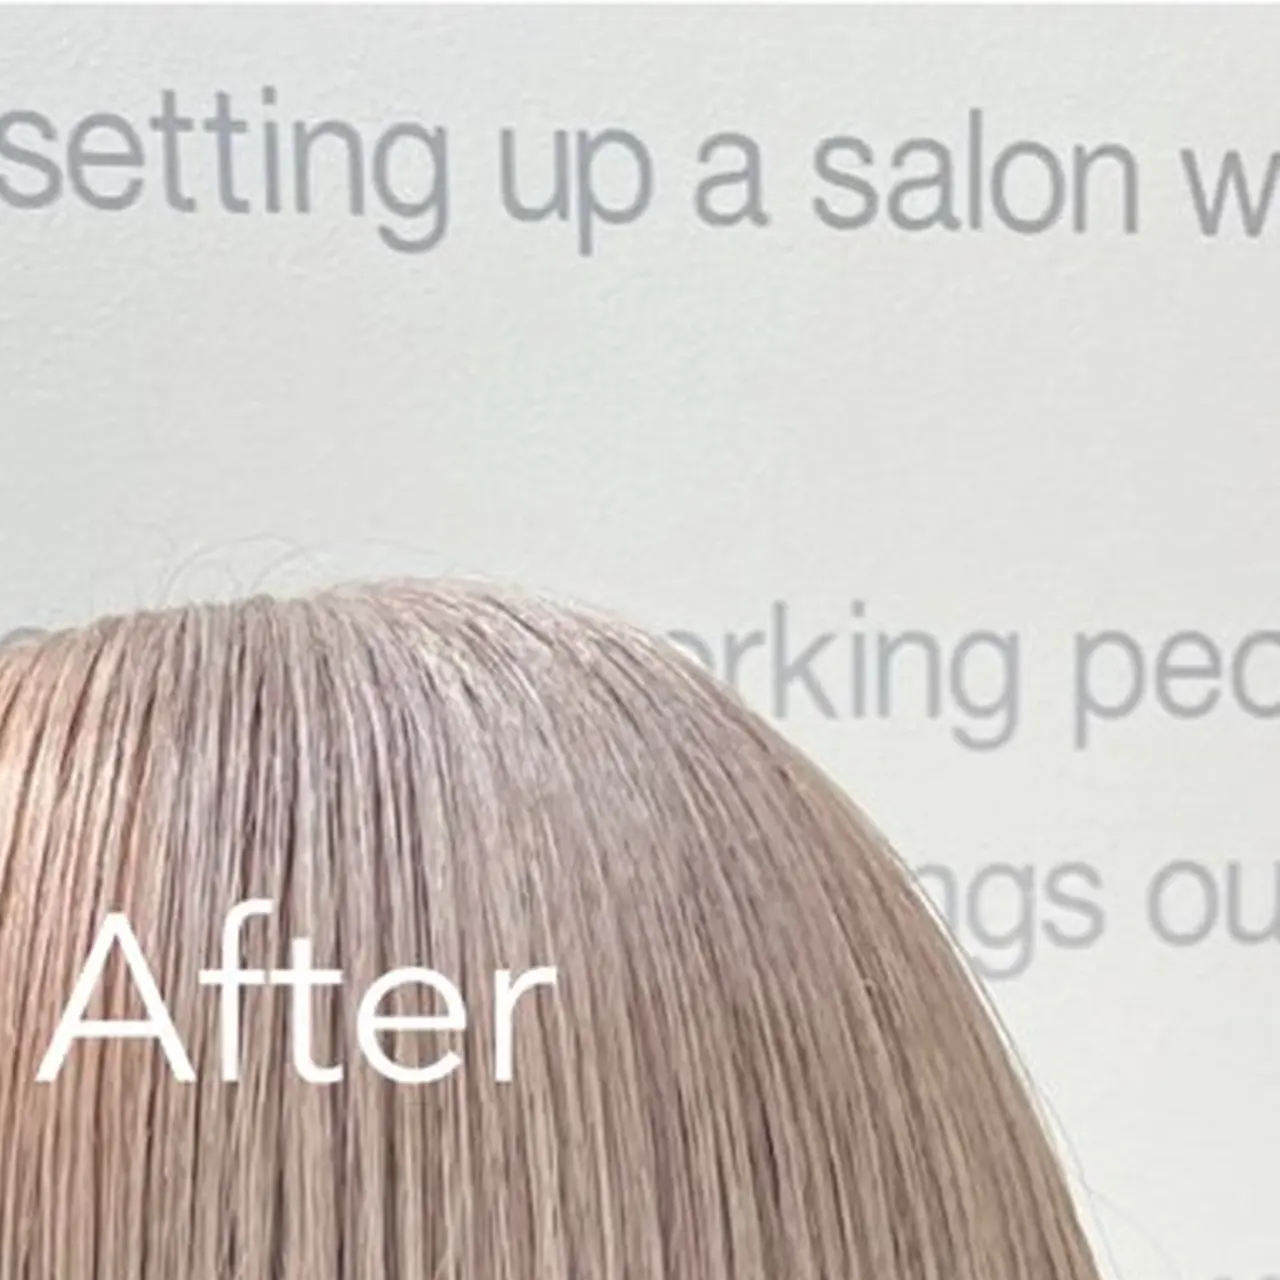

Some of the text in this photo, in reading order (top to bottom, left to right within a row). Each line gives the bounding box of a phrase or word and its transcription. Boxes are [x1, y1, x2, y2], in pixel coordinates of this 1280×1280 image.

[498, 124, 654, 256] up
[692, 129, 771, 227] a
[813, 107, 1141, 235] salon
